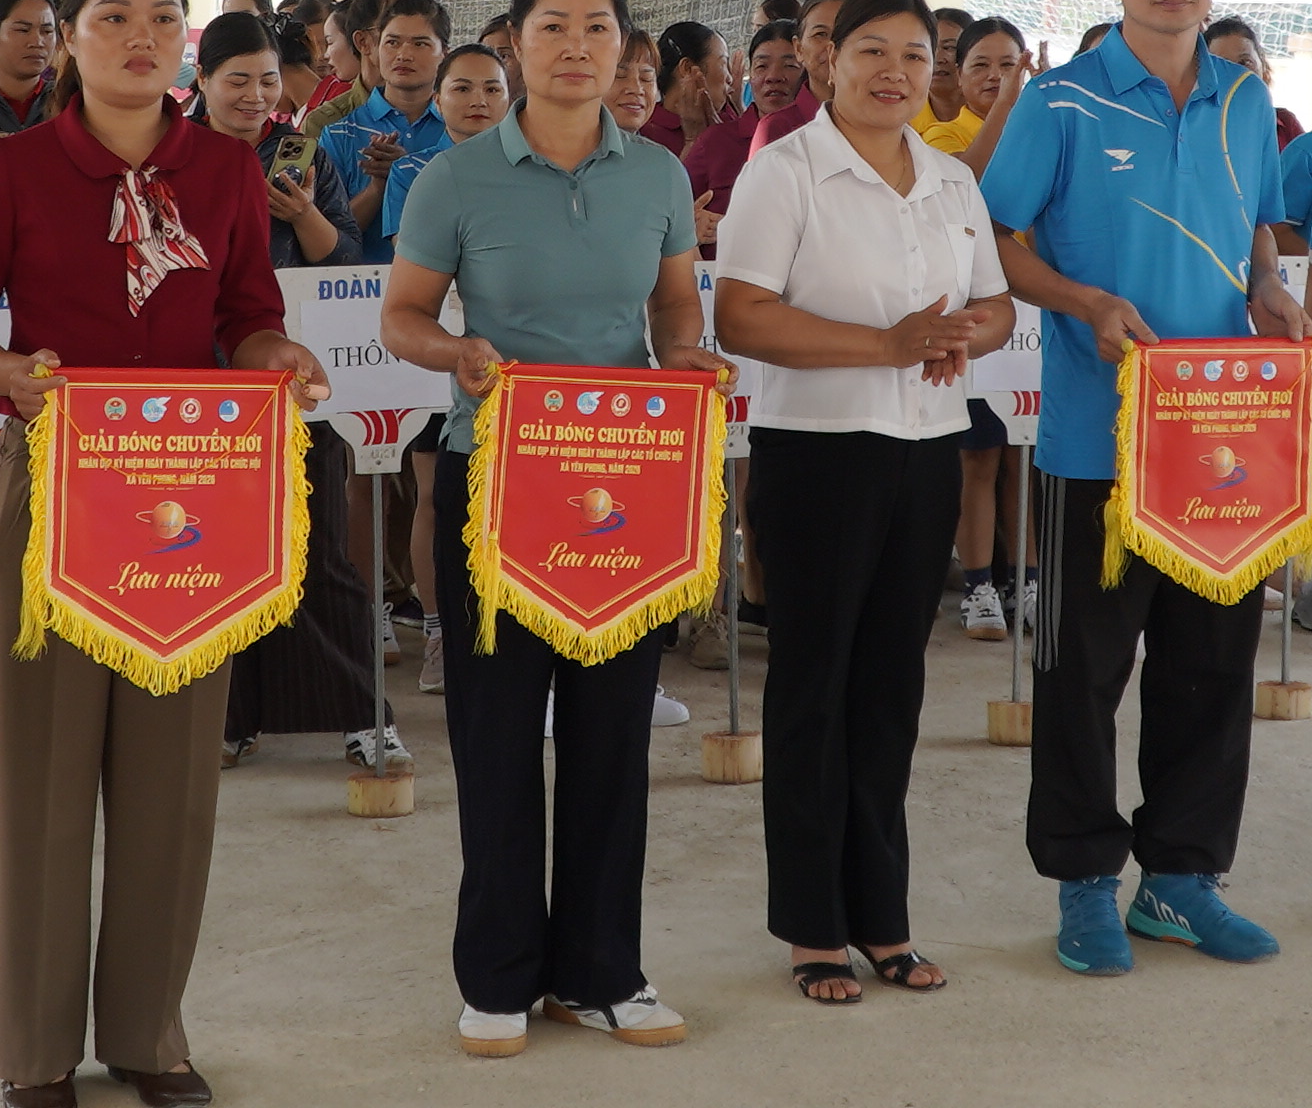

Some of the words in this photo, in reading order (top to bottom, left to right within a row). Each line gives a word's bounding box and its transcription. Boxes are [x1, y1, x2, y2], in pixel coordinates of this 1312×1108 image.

[318, 273, 381, 300] ĐOÀN
[1157, 387, 1184, 406] GIẢI
[1186, 388, 1220, 406] BÓNG
[1221, 385, 1269, 405] CHUYỀN
[1271, 389, 1292, 405] HƠI
[78, 428, 115, 452] GIẢI
[117, 430, 163, 452] BÓNG
[166, 428, 231, 452] CHUYỀN
[234, 433, 263, 452] HƠI
[519, 418, 552, 440] GIẢI
[554, 421, 596, 442] BÓNG
[597, 422, 657, 445] CHUYỀN
[659, 428, 685, 446] HƠI
[1177, 497, 1218, 526] Lưu
[1219, 497, 1263, 525] niệm
[538, 542, 588, 573] Lưu
[589, 546, 645, 576] niệm
[108, 562, 162, 596] Lưu
[165, 564, 225, 596] niệm
